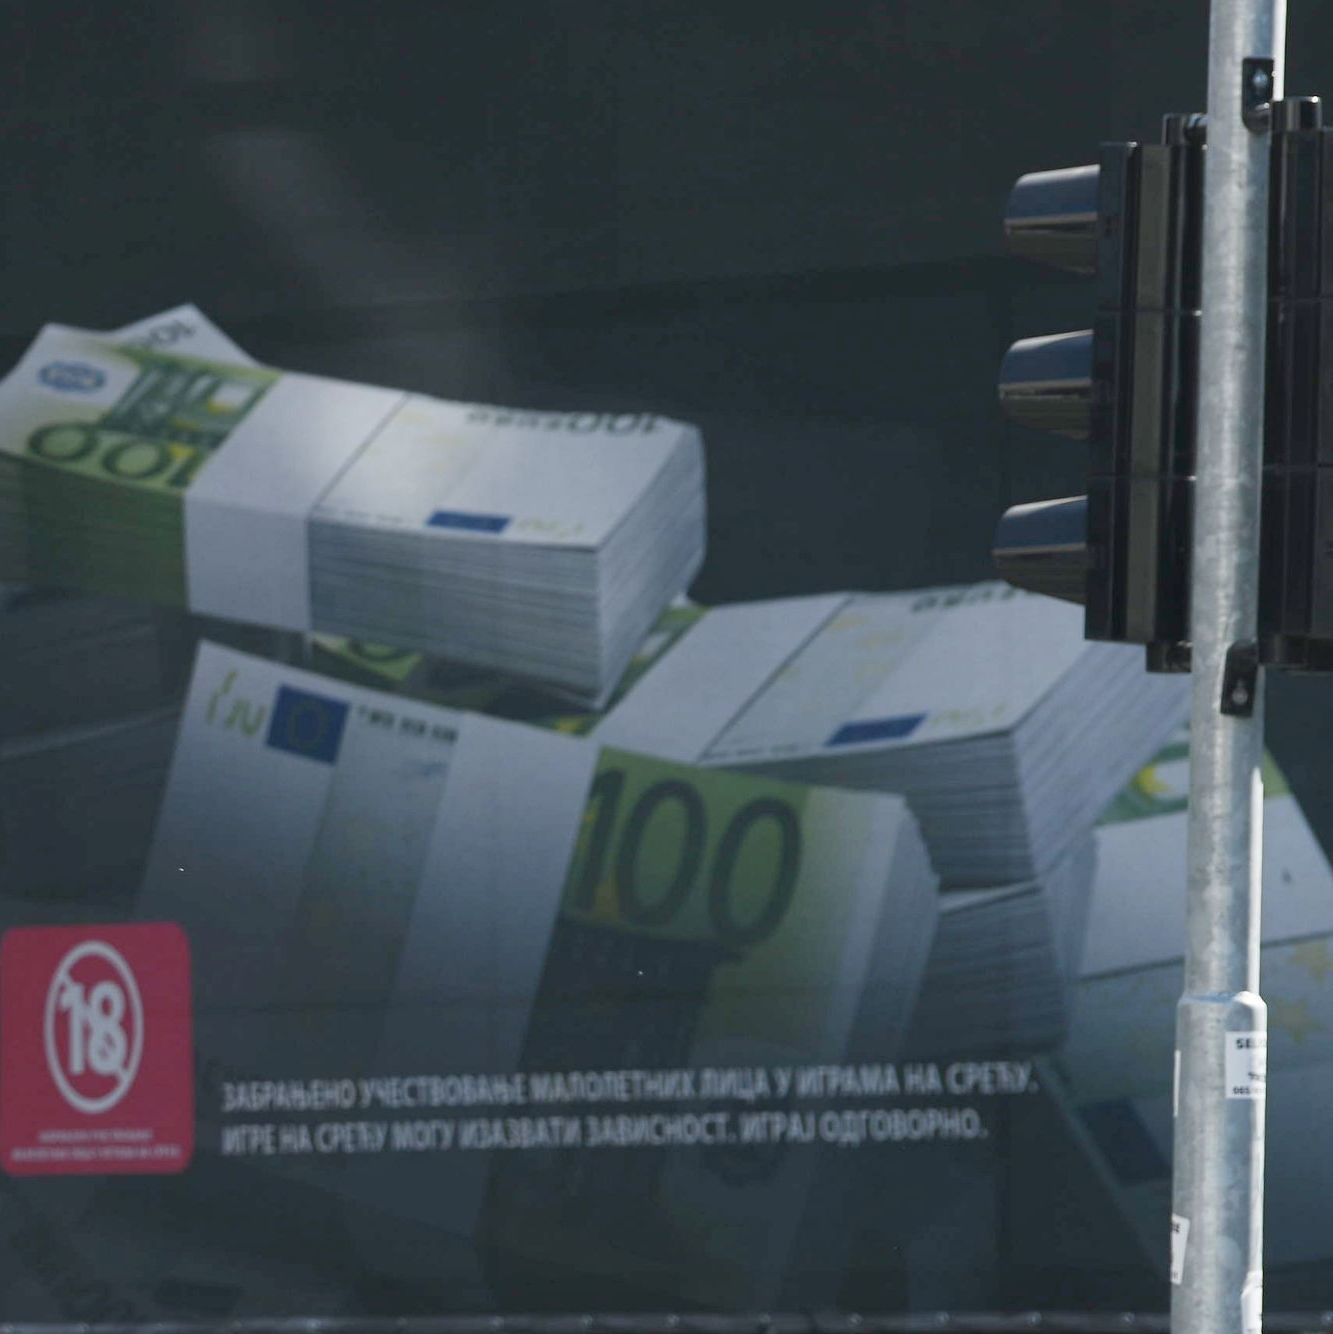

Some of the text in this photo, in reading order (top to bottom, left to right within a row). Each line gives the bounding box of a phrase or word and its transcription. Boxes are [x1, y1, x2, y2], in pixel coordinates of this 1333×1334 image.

[575, 769, 804, 947] 100
[58, 981, 128, 1075] 18
[223, 1079, 357, 1112] ЗАБРАЊЕНО
[359, 1073, 528, 1107] УЧЕСТВОВАЊЕ
[700, 1067, 771, 1104] ЛИЦА
[773, 1067, 792, 1097] У
[796, 1064, 901, 1097] ИГРАМА
[903, 1063, 943, 1094] НА
[222, 1124, 277, 1155] ИГРЕ
[280, 1123, 314, 1152] НА
[315, 1121, 387, 1152] СРЕЋУ
[390, 1119, 455, 1151] МОГУ
[740, 1110, 816, 1144] ИГРАЈ
